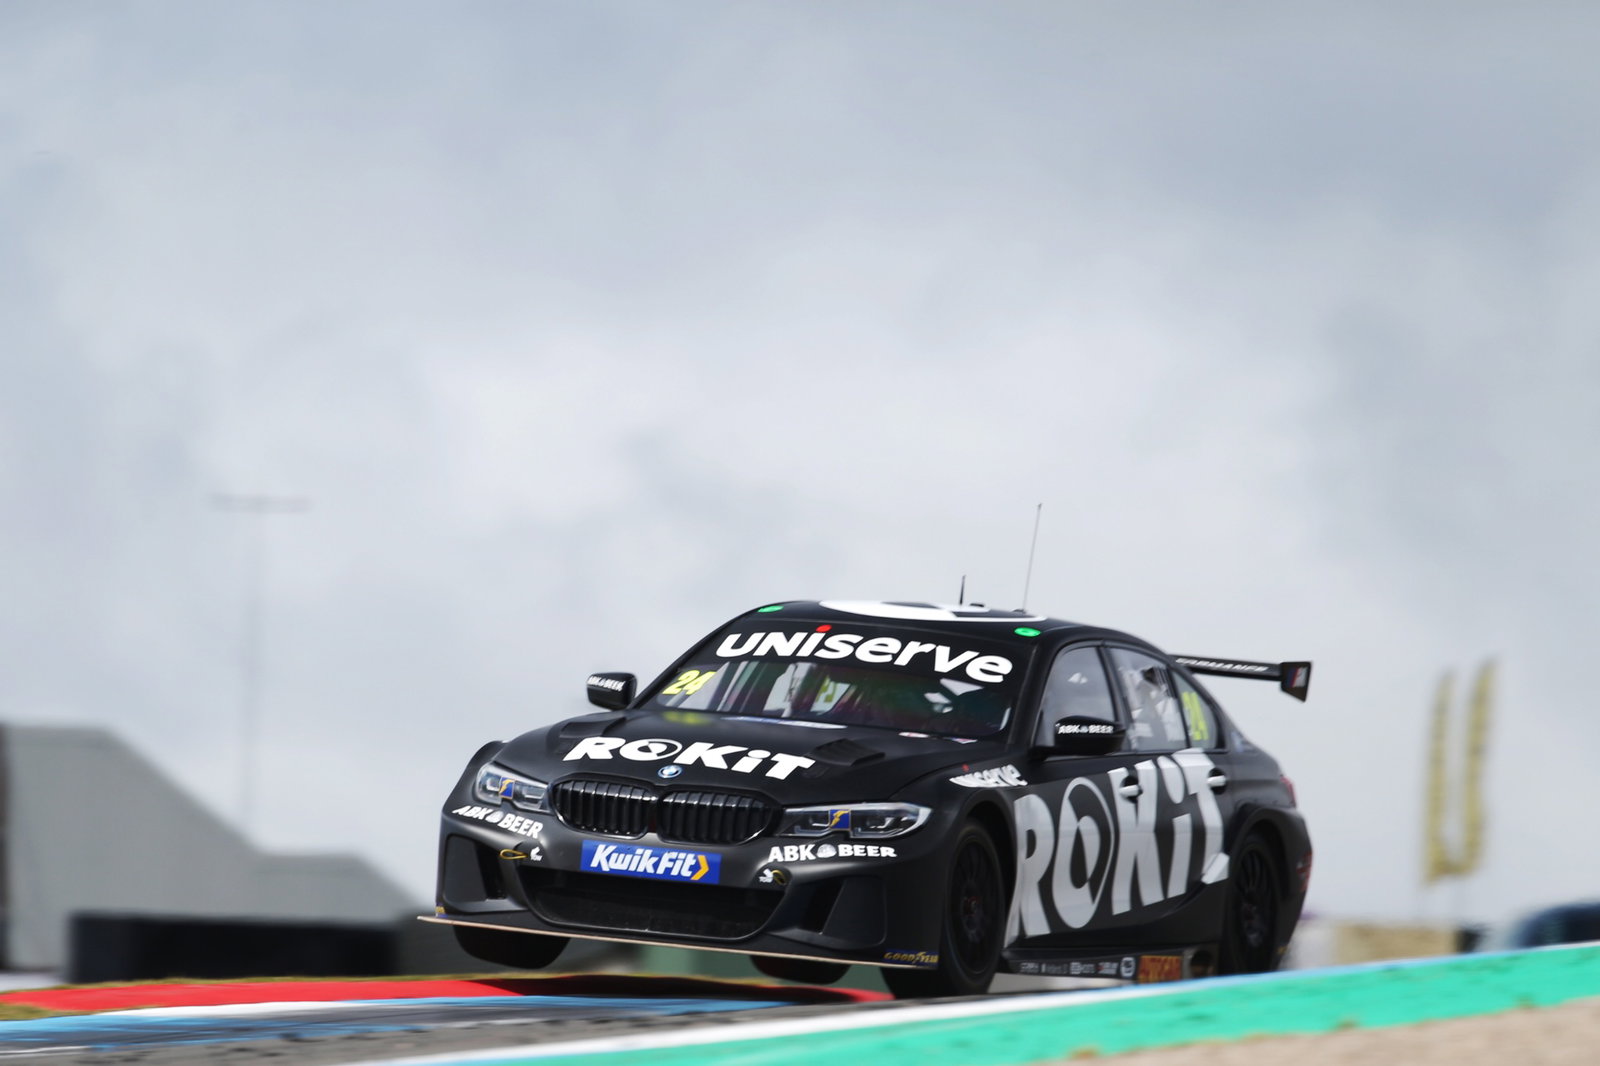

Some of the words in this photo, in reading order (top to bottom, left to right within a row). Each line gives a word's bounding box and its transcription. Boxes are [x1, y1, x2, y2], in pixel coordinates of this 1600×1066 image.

[661, 669, 717, 695] 24
[562, 736, 816, 780] ROKiT
[452, 805, 493, 820] ABK
[497, 813, 544, 839] BEER
[768, 844, 816, 862] ABK
[838, 844, 897, 858] BEER
[1004, 747, 1230, 949] ROKiT
